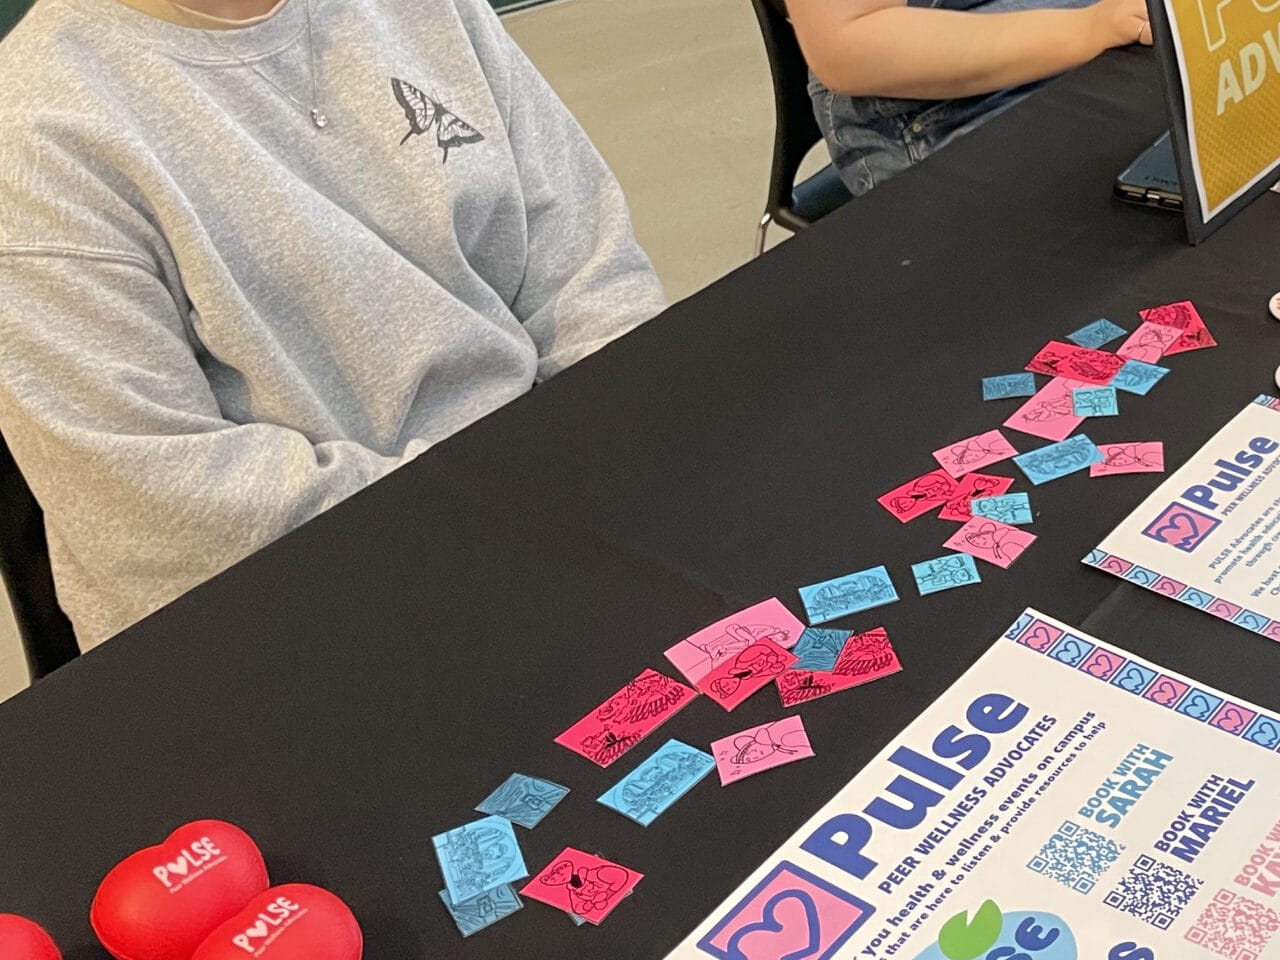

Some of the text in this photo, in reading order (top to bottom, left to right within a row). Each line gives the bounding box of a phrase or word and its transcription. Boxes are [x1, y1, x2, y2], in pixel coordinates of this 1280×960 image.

[1179, 434, 1280, 510] Pulse
[1220, 502, 1238, 516] PEER
[1234, 475, 1265, 502] WELLNESS
[1208, 548, 1232, 569] PULSE
[1228, 516, 1264, 548] Advocates
[1262, 506, 1274, 516] are
[1238, 534, 1264, 555] health
[1250, 586, 1266, 597] We
[798, 693, 1030, 881] Pulse
[876, 714, 1058, 894] PEER WELLNESS ADVOCATES
[1077, 742, 1150, 818] BOOK WITH
[1094, 748, 1174, 829] SARAH
[1153, 774, 1224, 852] BOOK WITH
[860, 710, 1098, 958] you health & wellness events on campus
[884, 721, 1107, 956] that are here to listen & provide resources to help
[1169, 775, 1256, 864] MARIEL
[1233, 842, 1274, 887] BOOK
